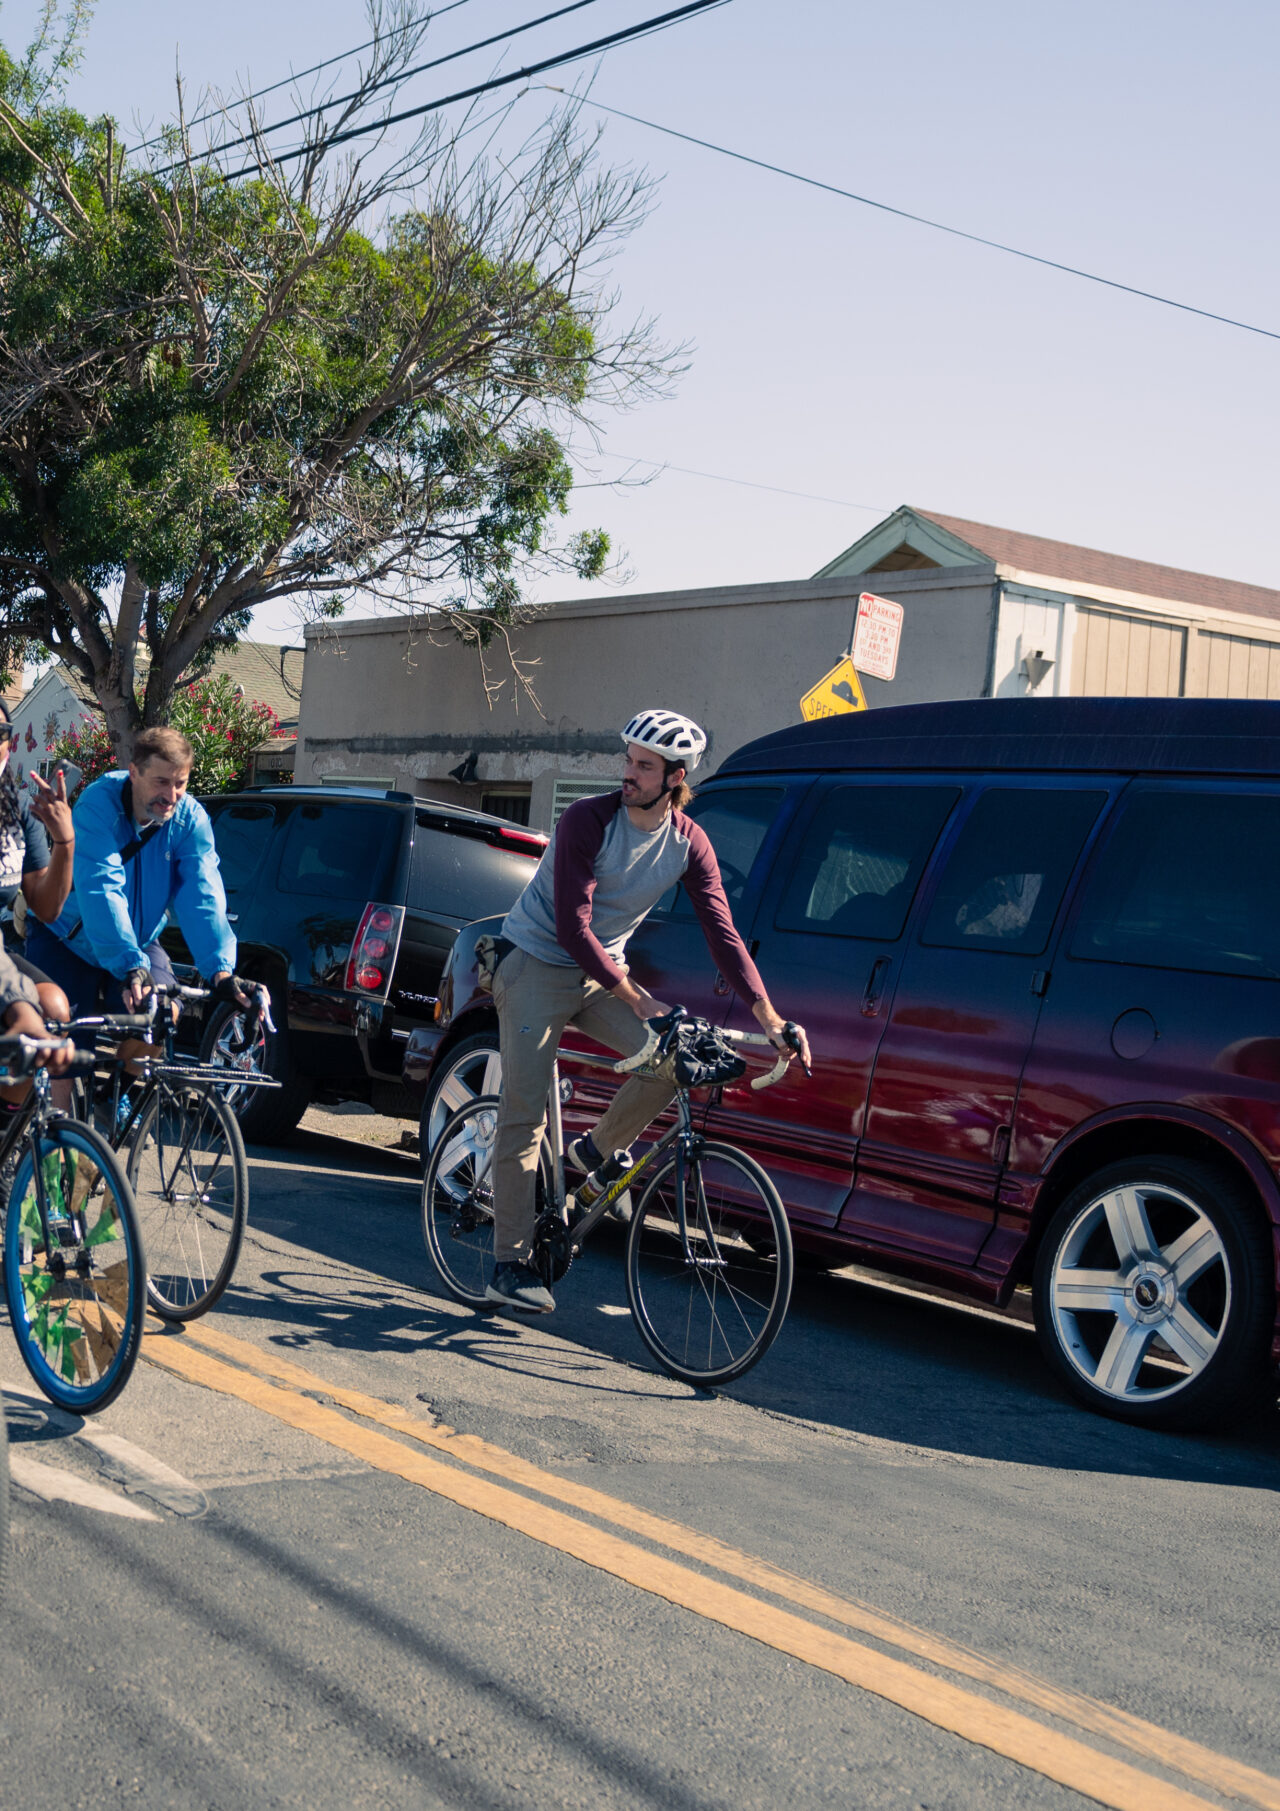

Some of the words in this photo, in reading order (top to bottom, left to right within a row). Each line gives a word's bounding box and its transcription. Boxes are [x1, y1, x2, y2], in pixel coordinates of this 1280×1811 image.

[860, 599, 873, 617] NO
[873, 604, 900, 622] PARKING
[878, 624, 887, 634] PM
[888, 627, 896, 638] TO
[868, 641, 881, 652] AND
[880, 635, 889, 645] PM
[860, 647, 889, 665] TUESDAYS
[808, 697, 838, 718] SPEE
